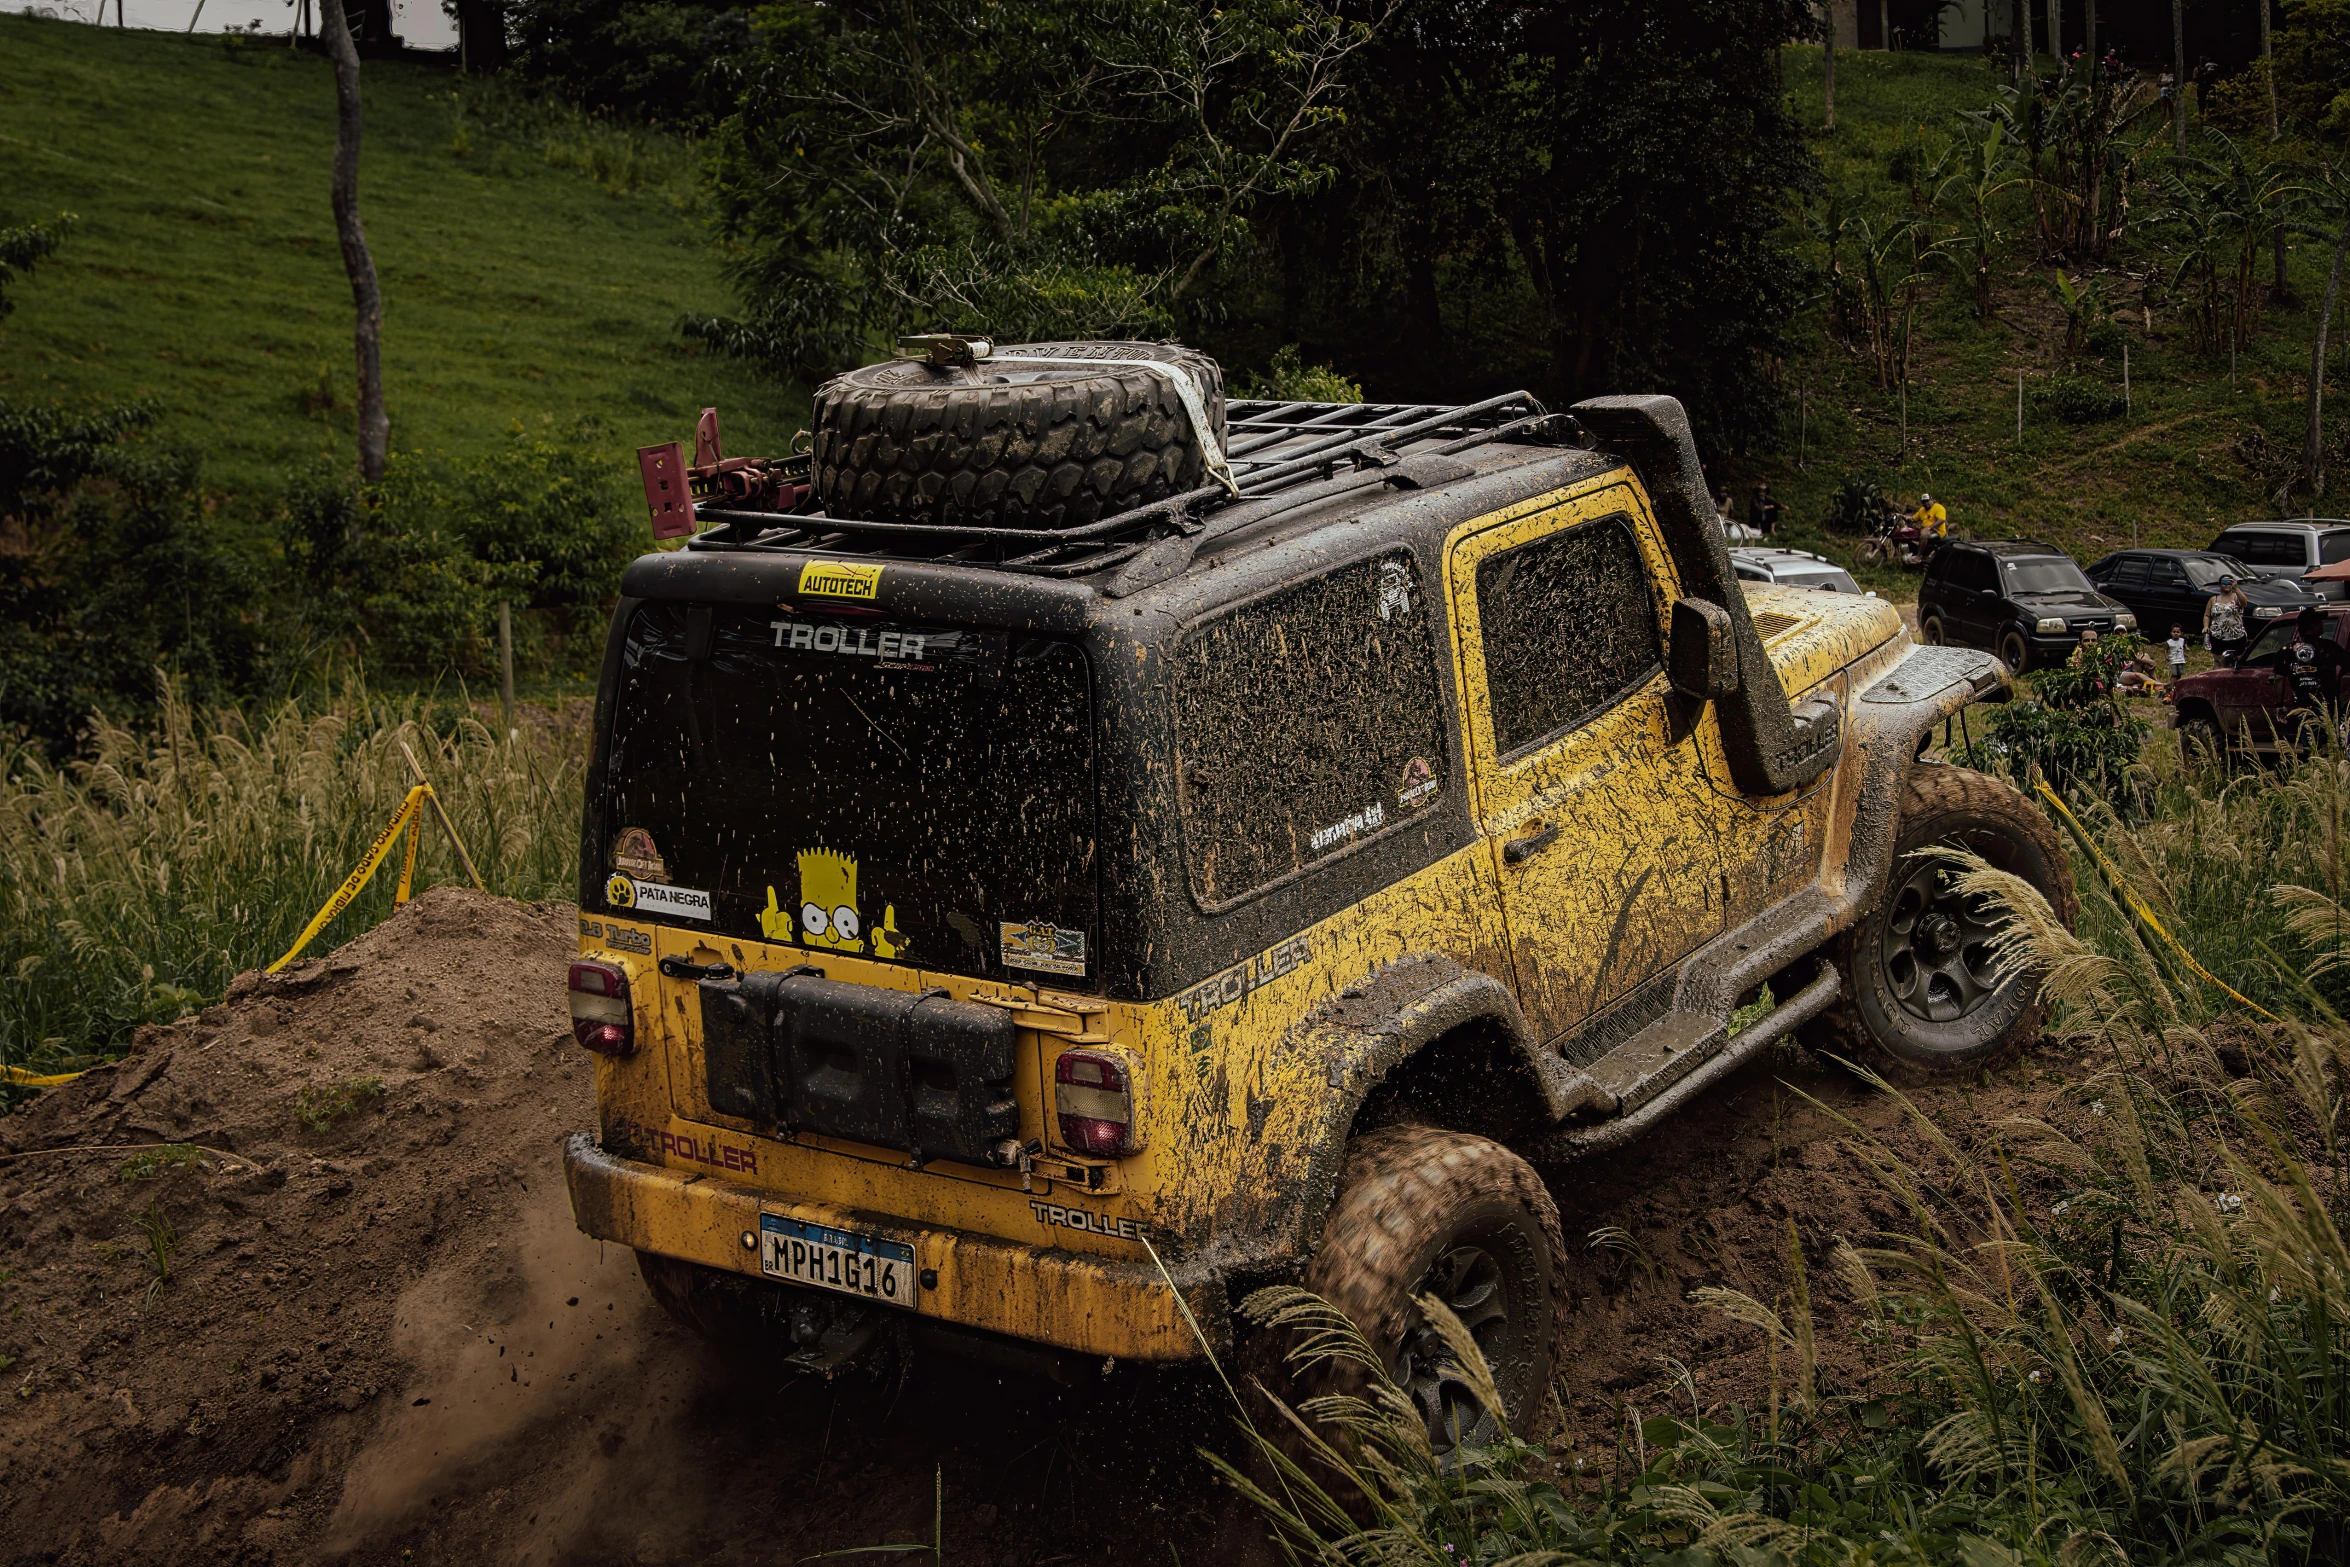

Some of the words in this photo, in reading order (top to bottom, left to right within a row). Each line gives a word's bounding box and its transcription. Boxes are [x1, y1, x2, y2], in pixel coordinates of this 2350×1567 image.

[803, 575, 873, 597] AUTOTECH
[770, 621, 926, 660] TROLLER
[346, 875, 361, 892] DE
[639, 886, 668, 902] PATA
[669, 891, 710, 909] NEGRA
[605, 923, 651, 946] Turbo
[1179, 934, 1313, 1024] TROLLER
[643, 1127, 758, 1176] TROLLER
[773, 1236, 897, 1298] MPH1G16
